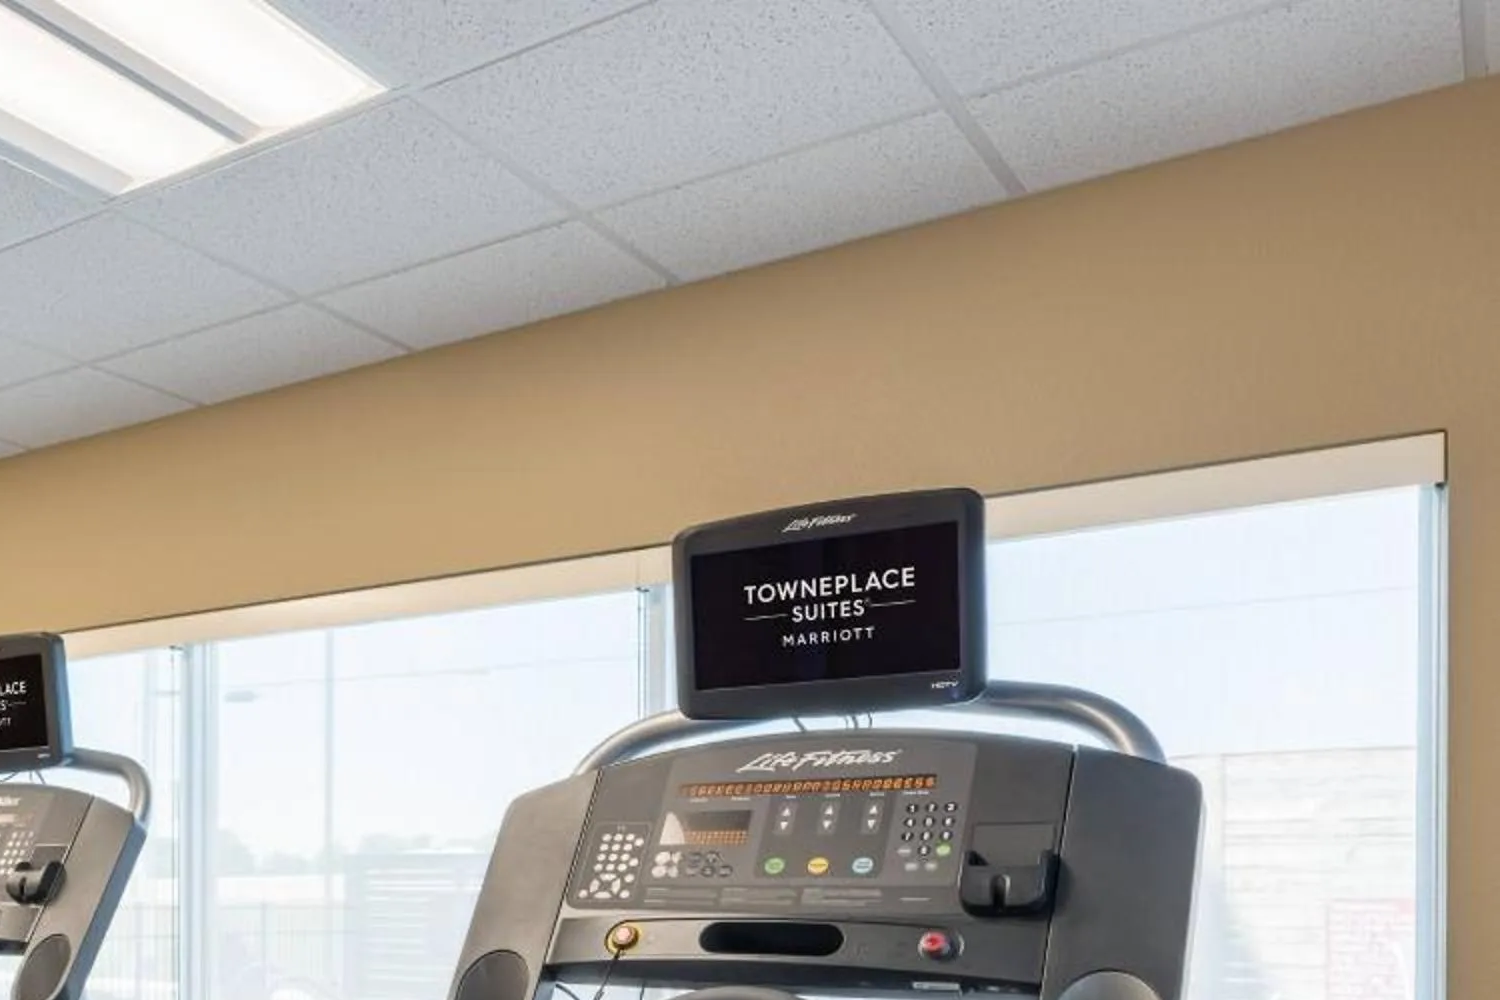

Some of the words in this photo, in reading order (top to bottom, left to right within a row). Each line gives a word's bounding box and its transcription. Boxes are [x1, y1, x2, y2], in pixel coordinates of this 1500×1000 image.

[744, 566, 916, 605] TOWNEPLACE
[791, 599, 866, 623] SUITES
[782, 626, 876, 648] MARRIOTT
[735, 751, 798, 774] Life
[792, 749, 898, 772] Fitness
